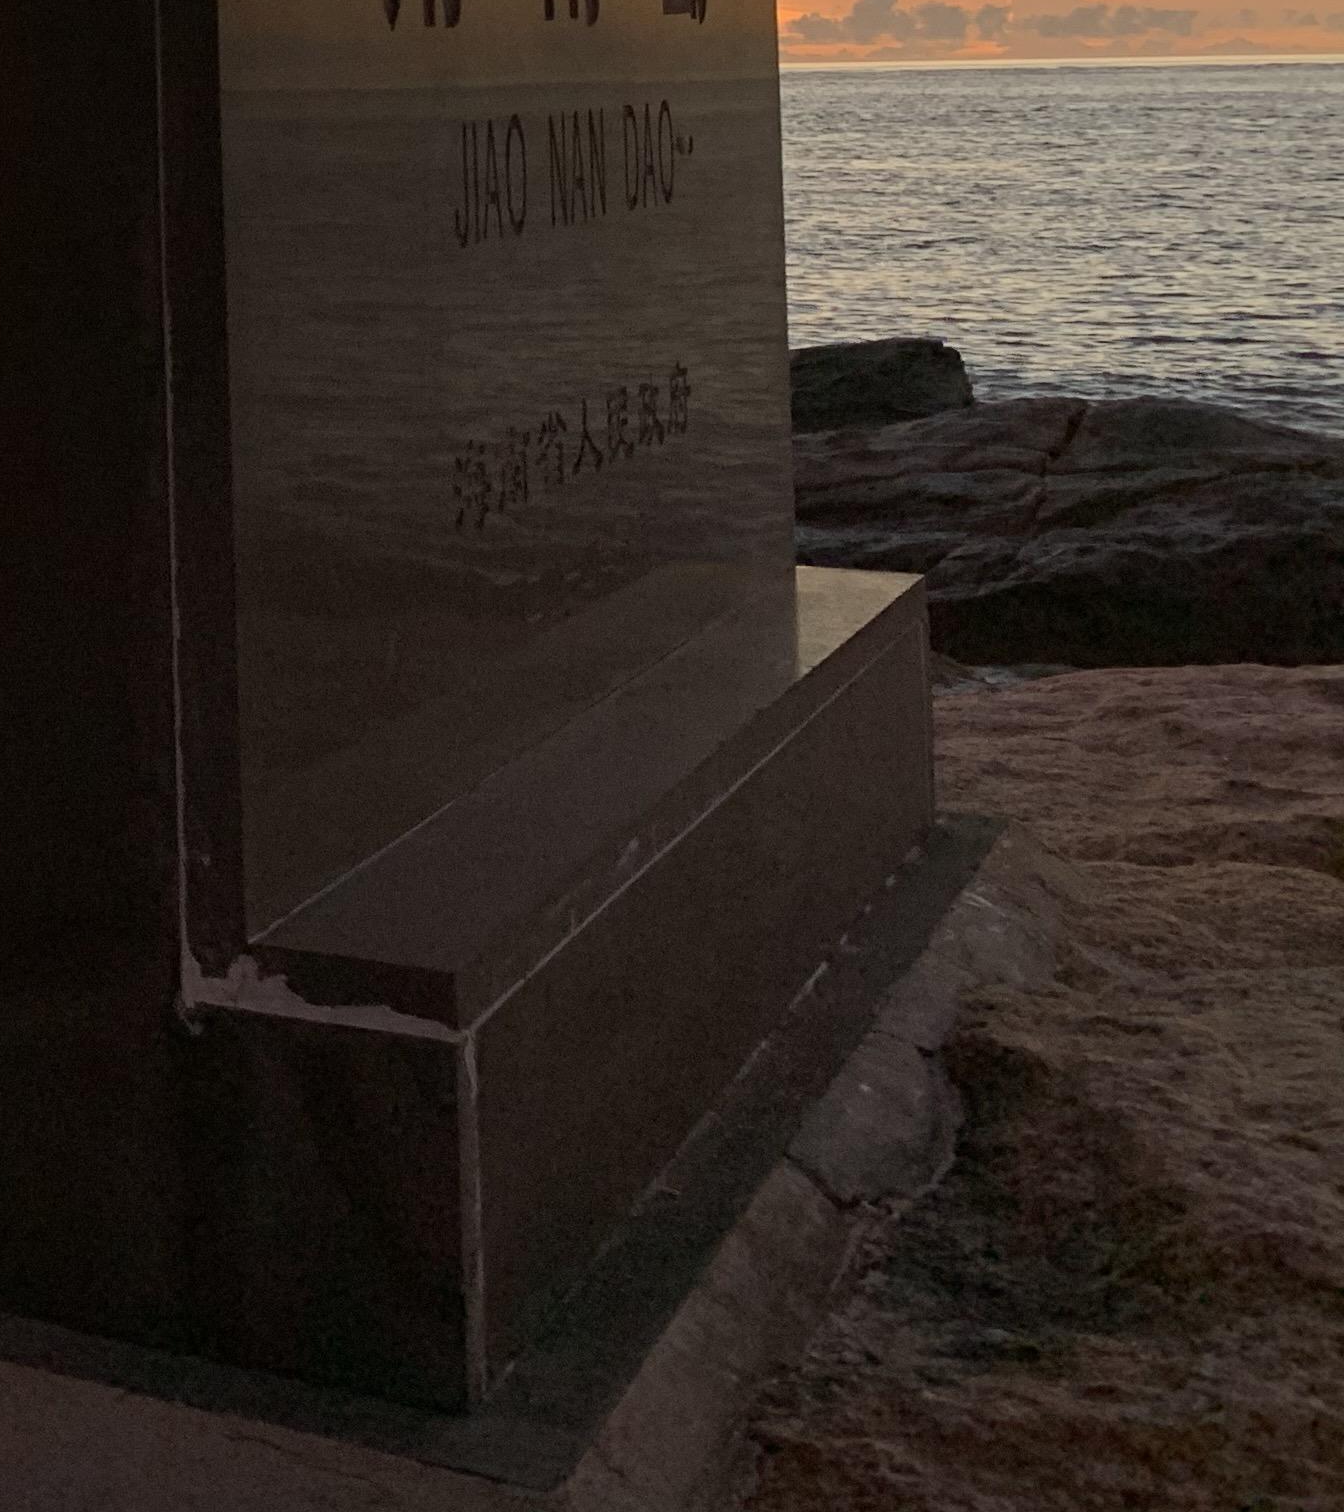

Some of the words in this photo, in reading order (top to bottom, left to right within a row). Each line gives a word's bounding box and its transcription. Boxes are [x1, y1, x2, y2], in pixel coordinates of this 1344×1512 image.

[454, 115, 527, 248] JIAO
[549, 107, 607, 227] NAN
[622, 99, 674, 210] DAO
